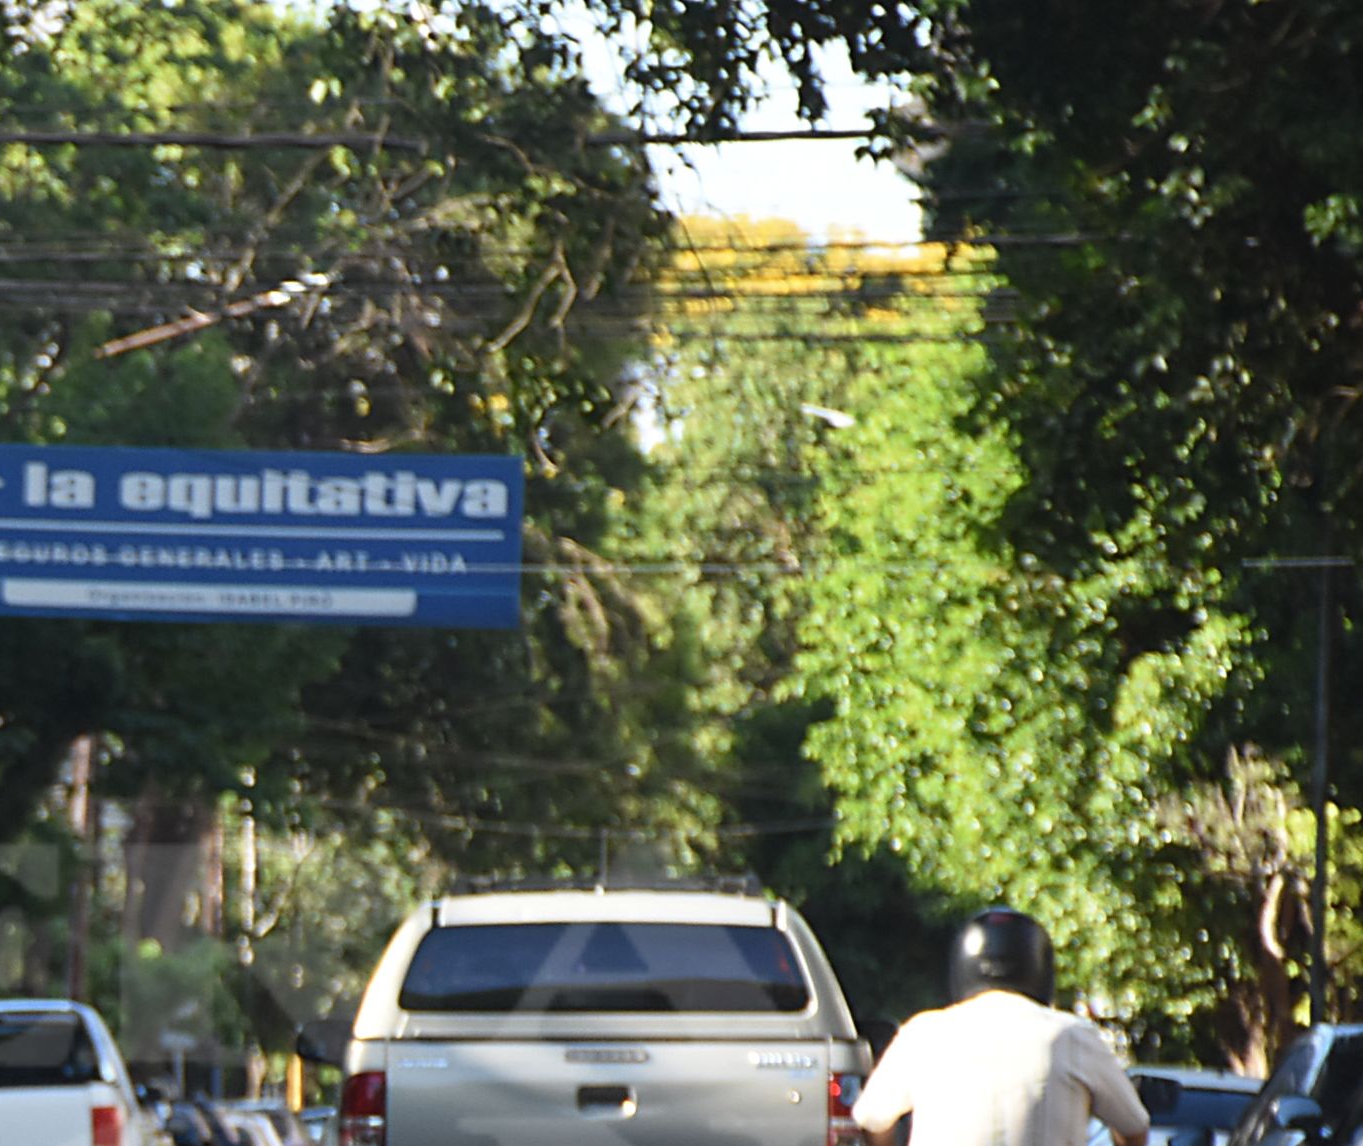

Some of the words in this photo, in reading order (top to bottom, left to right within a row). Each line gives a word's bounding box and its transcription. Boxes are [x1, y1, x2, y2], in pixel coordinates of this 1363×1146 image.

[25, 461, 96, 510] la
[120, 468, 509, 519] equitativa
[120, 546, 284, 572] GENERALES
[316, 549, 370, 573] ART
[400, 554, 468, 575] VIDA
